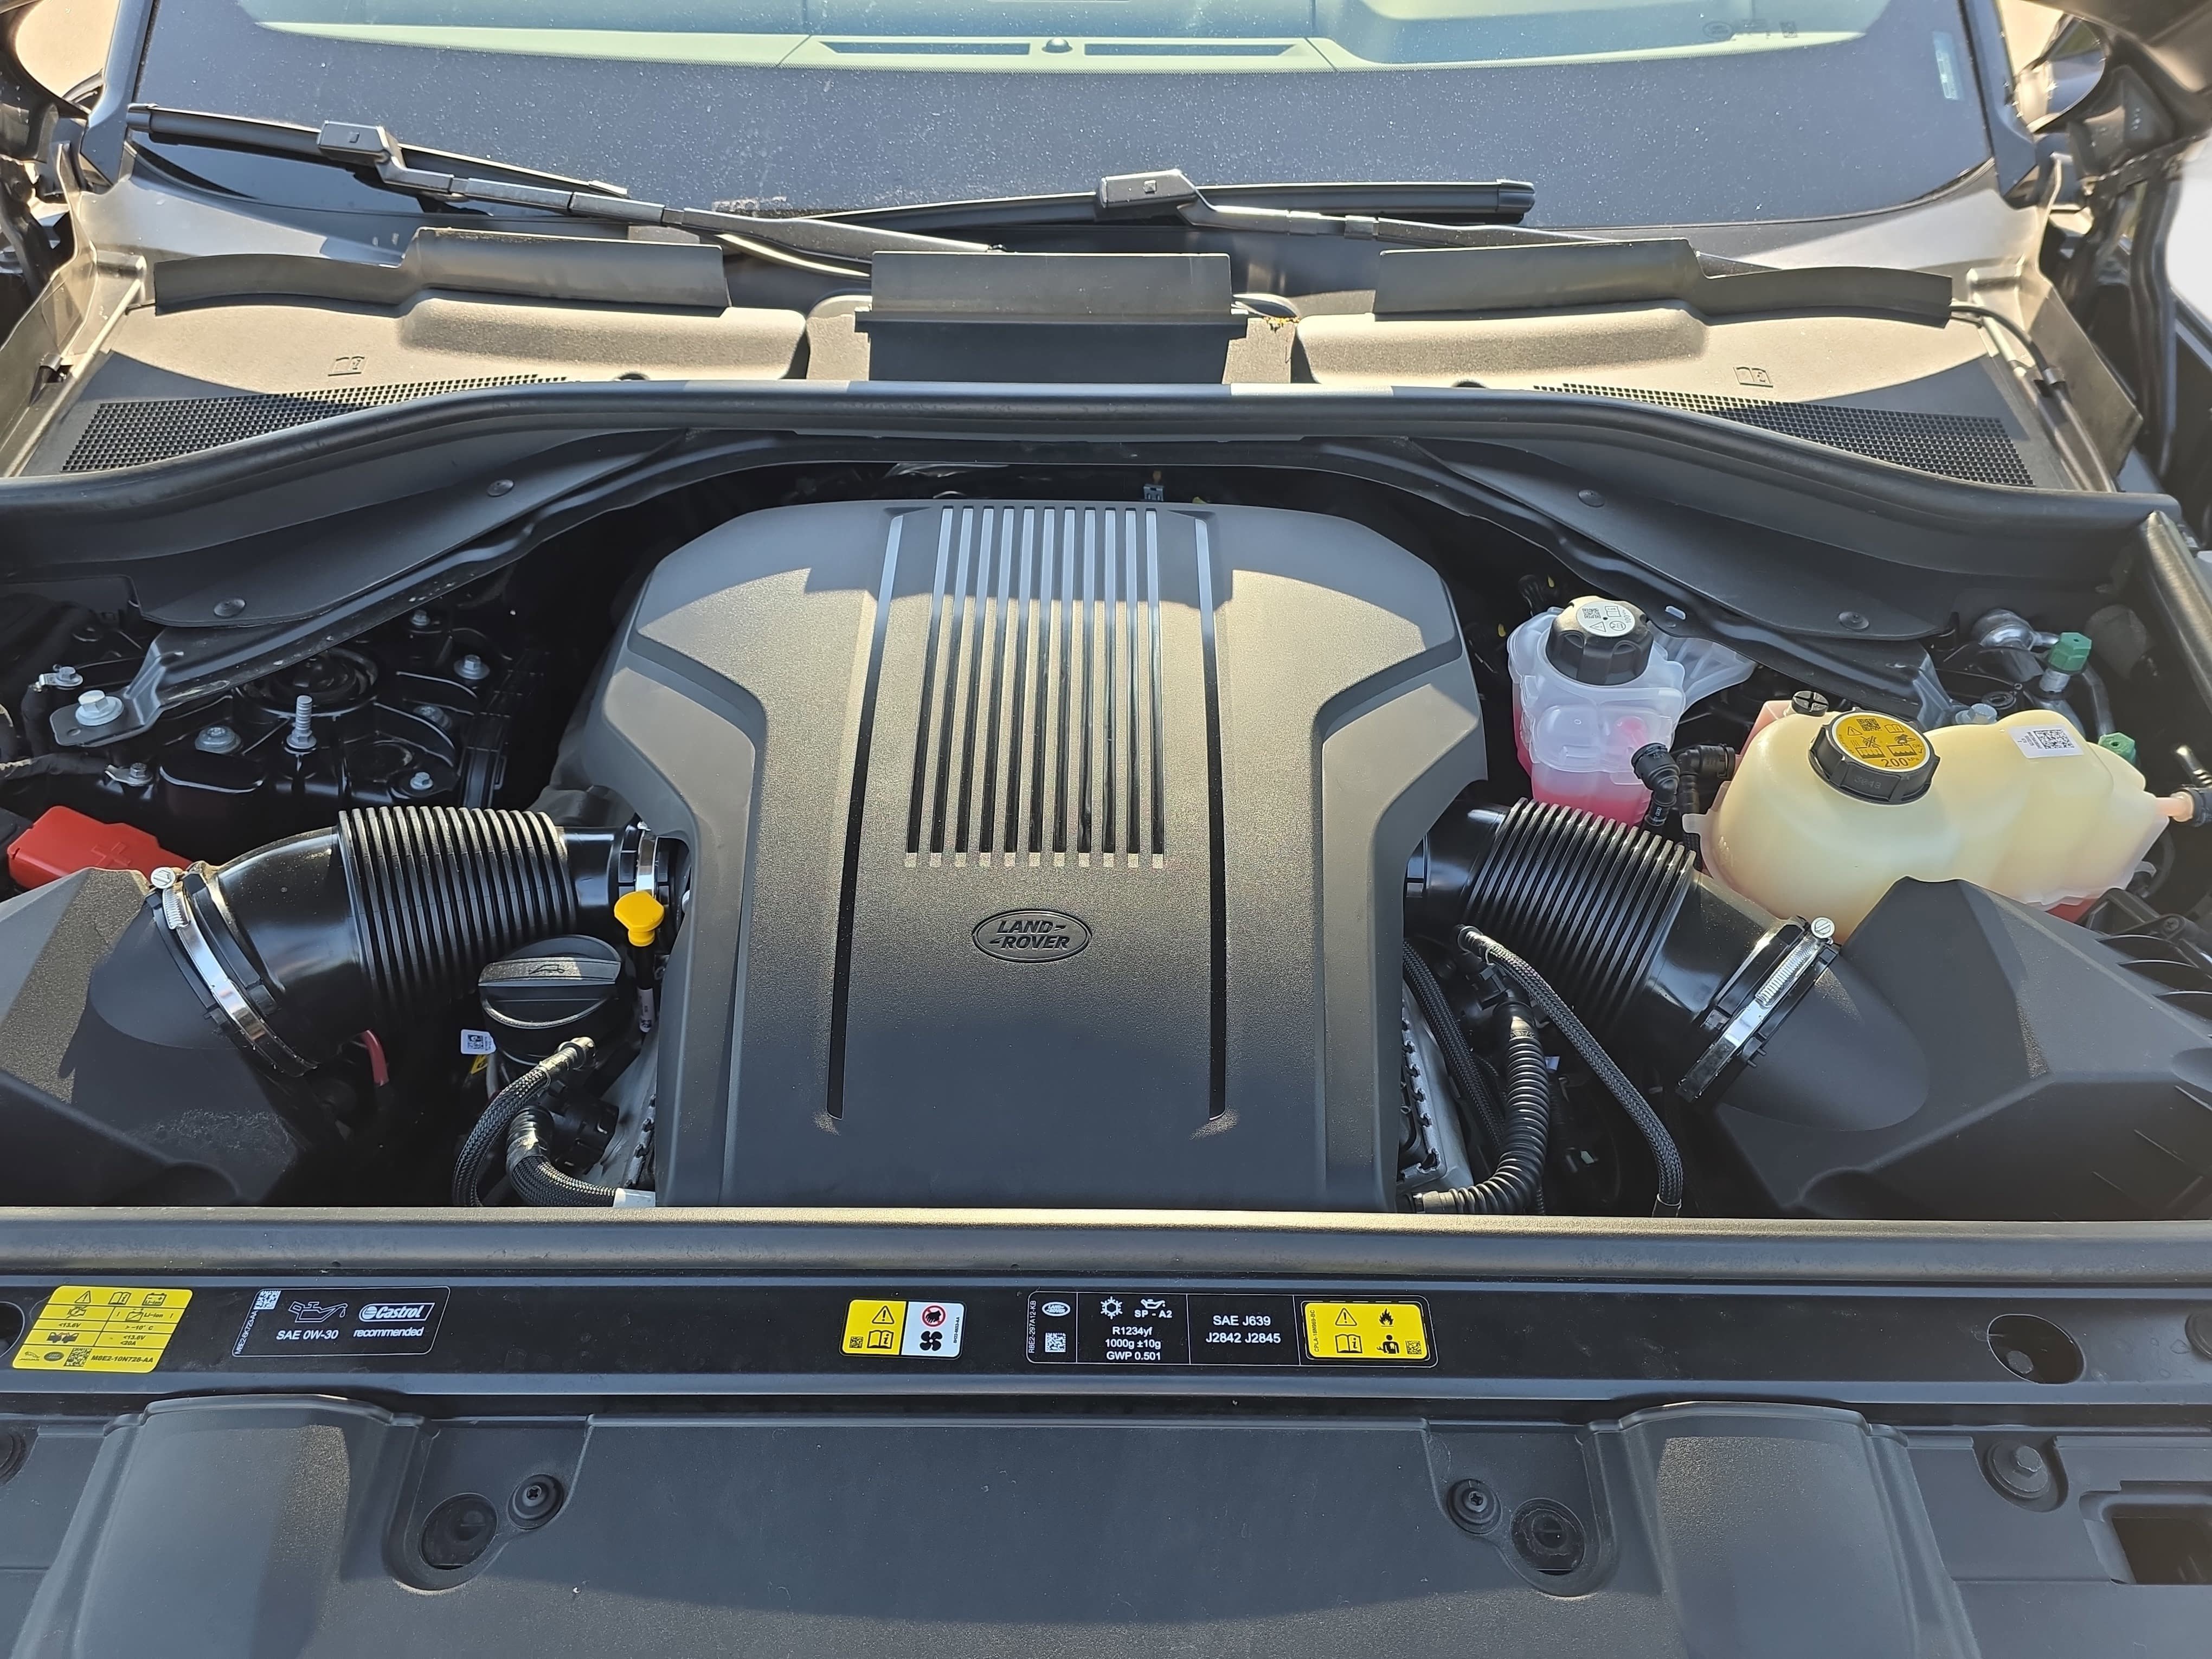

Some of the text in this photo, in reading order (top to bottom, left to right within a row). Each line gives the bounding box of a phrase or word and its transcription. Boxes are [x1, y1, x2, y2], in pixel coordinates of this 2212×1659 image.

[1881, 757, 1908, 767] 200
[996, 921, 1053, 934] LAND
[1000, 936, 1070, 949] ROVER
[376, 1305, 425, 1319] Castrol
[1134, 1310, 1148, 1318] SP
[1158, 1310, 1172, 1318] A2
[1213, 1315, 1271, 1327] SAE J639
[276, 1329, 339, 1340] SAE 0W-30
[353, 1327, 425, 1337] recommended
[1112, 1327, 1153, 1338] R1234yf
[1205, 1332, 1281, 1344] J2842 J2845
[1105, 1339, 1161, 1349] 1000g ±10g
[1107, 1352, 1161, 1360] GWP 0.501
